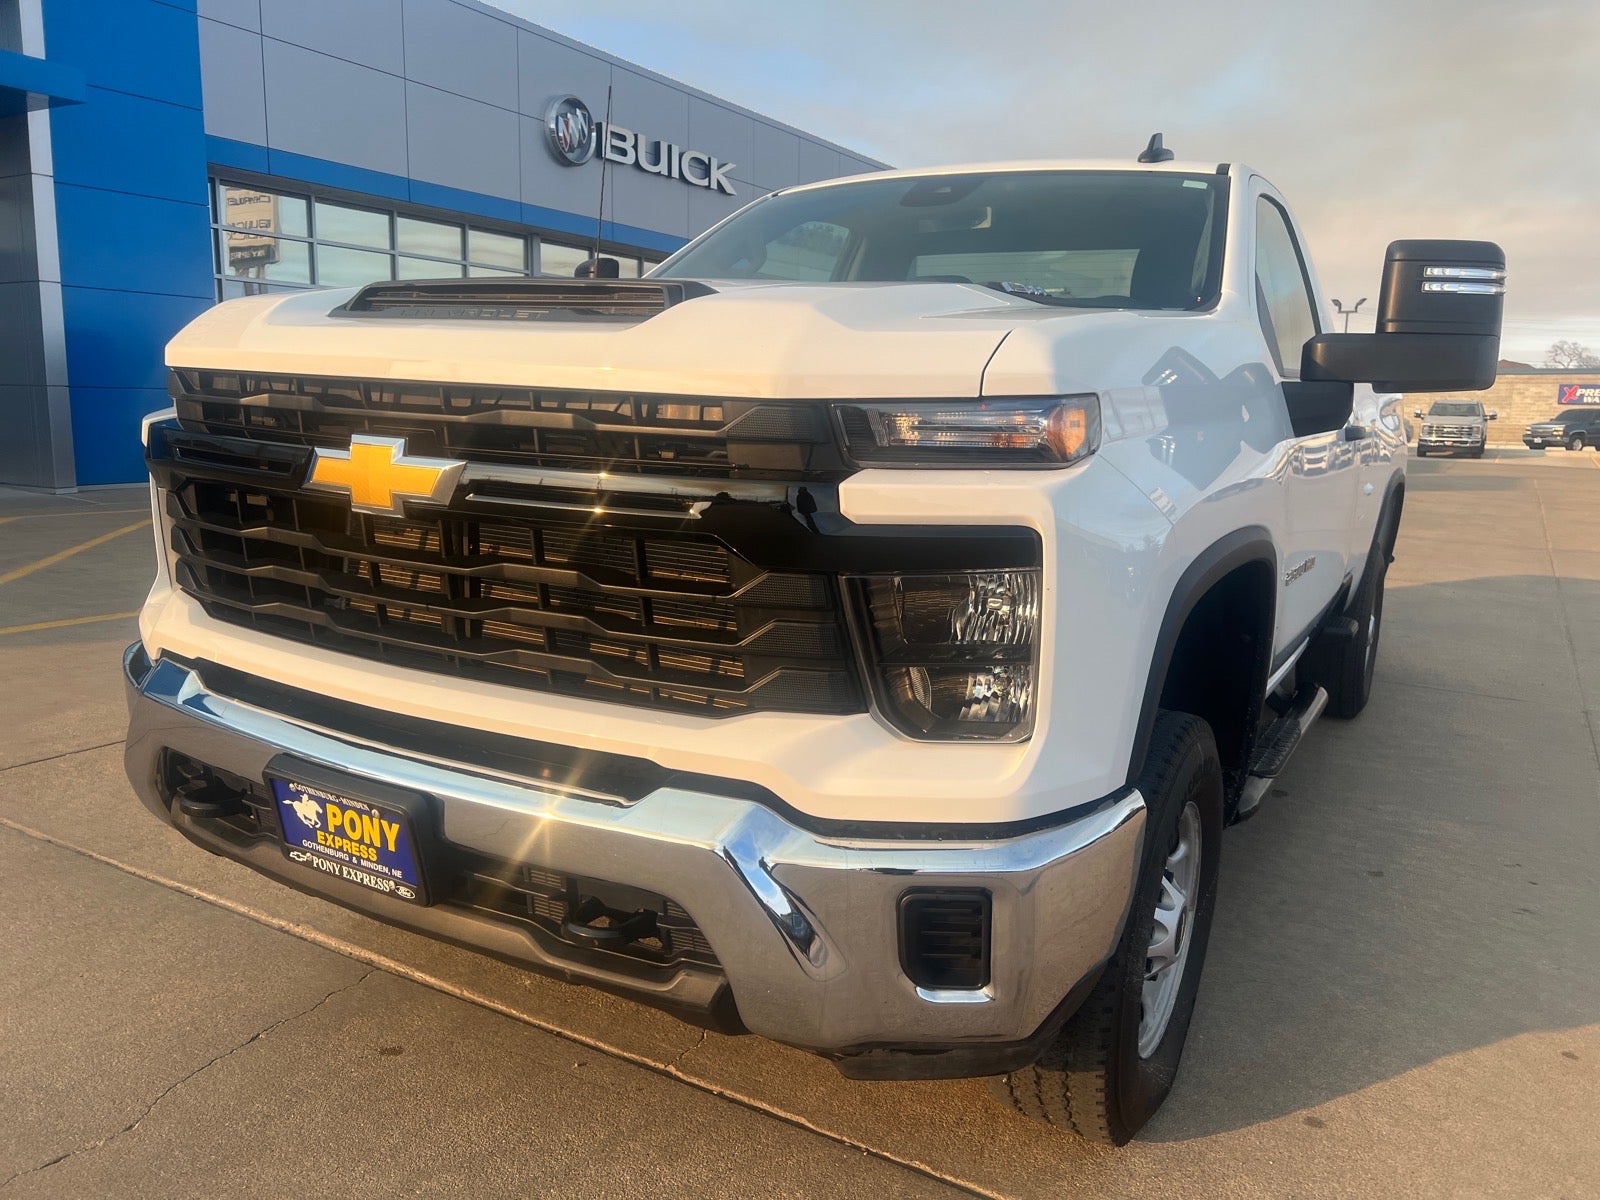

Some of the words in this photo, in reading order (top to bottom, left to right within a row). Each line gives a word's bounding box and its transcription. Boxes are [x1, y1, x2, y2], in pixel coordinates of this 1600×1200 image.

[601, 121, 737, 196] BUICK
[316, 830, 377, 862] EXPRESS
[326, 803, 400, 852] PONY
[302, 839, 350, 861] GOTHENBURG
[352, 856, 358, 864] &
[360, 860, 391, 875] MINDEN,
[391, 868, 403, 878] NE
[312, 855, 341, 877] PONY
[343, 865, 390, 893] EXPRESS
